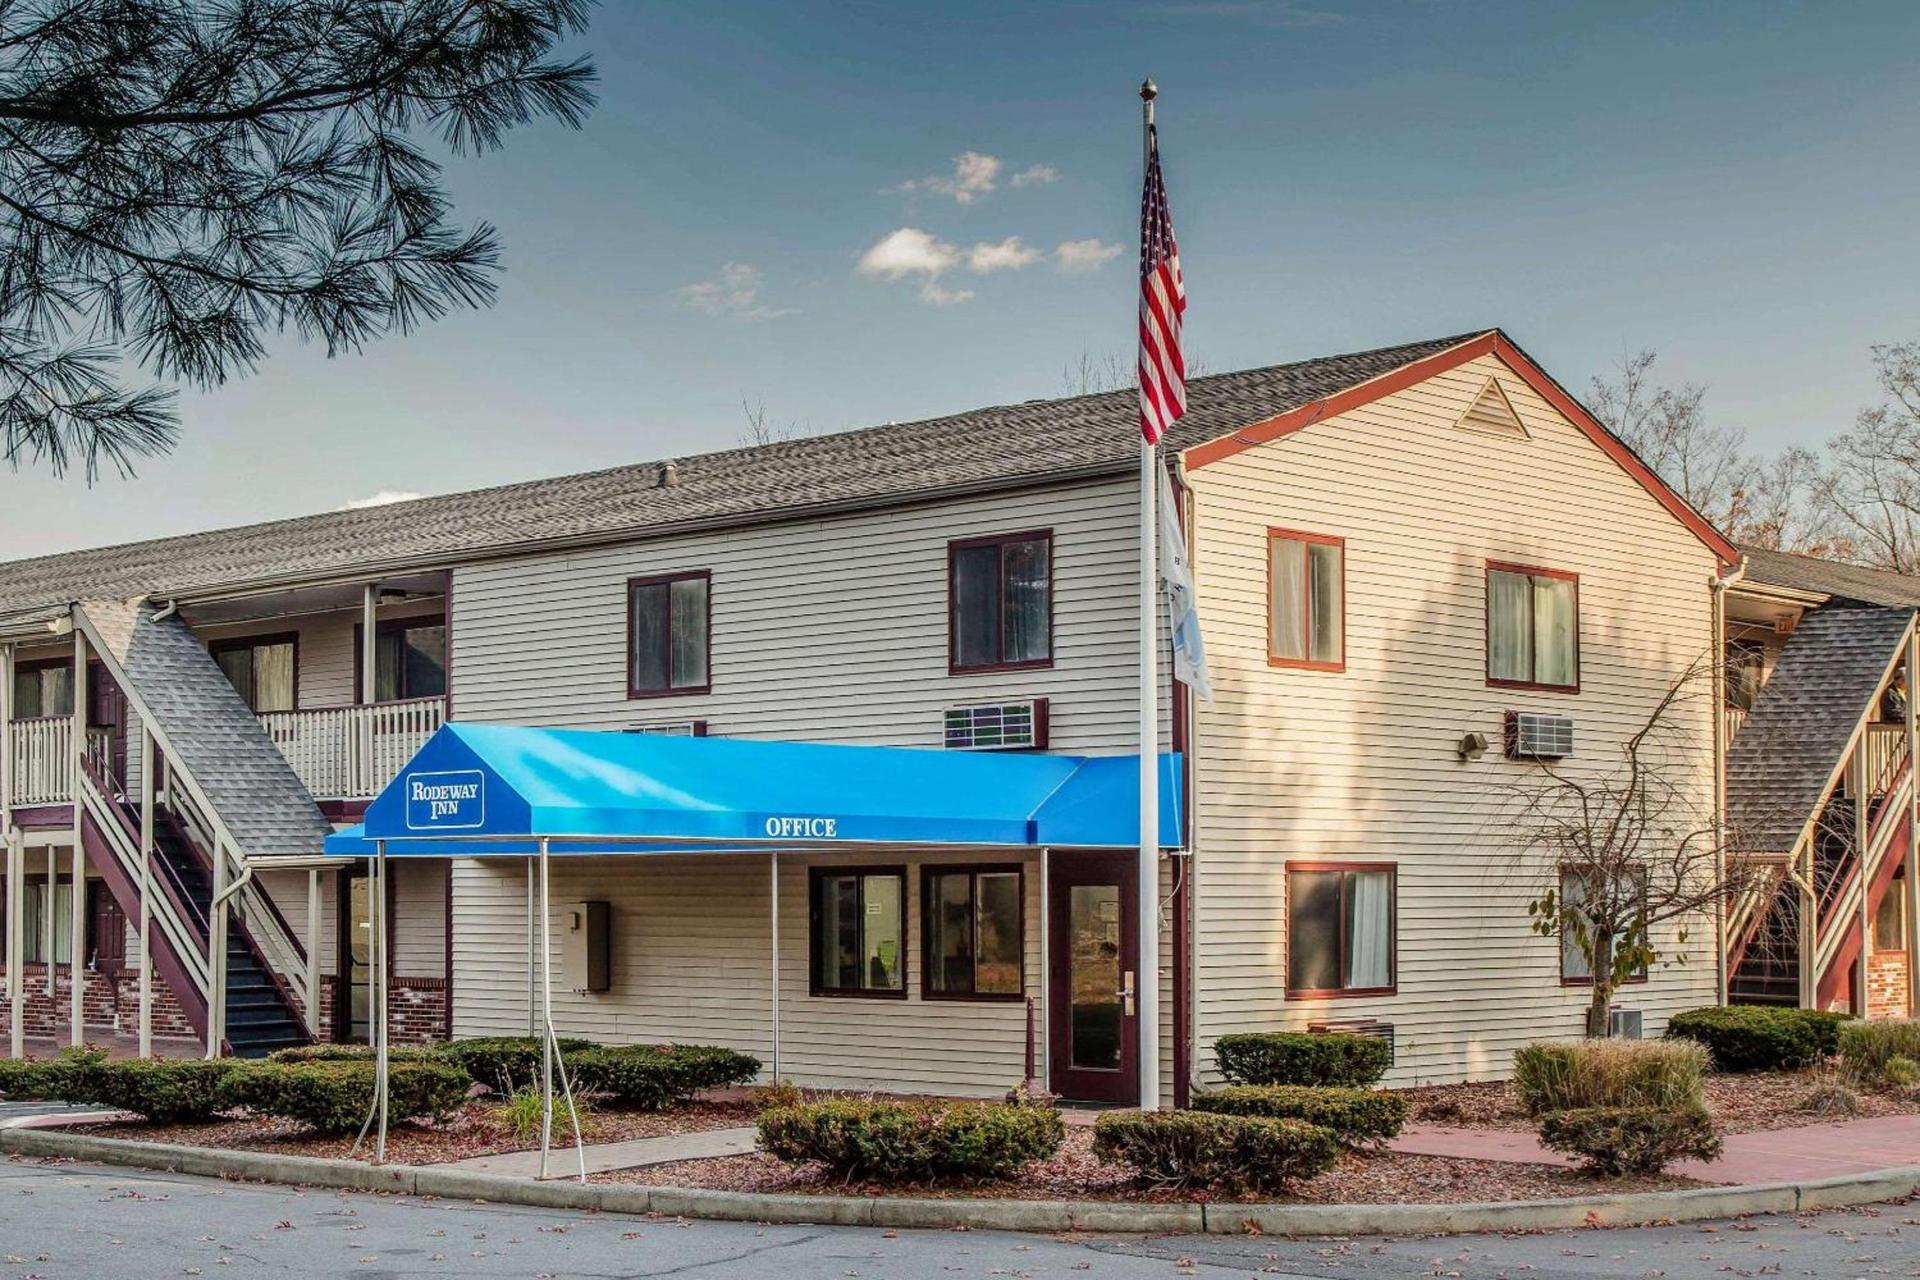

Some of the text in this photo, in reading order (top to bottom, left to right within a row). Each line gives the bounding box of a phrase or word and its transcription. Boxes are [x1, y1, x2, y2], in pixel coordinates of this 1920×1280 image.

[412, 782, 478, 800] RODEWAY
[430, 801, 458, 819] INN
[766, 817, 837, 837] OFFICE
